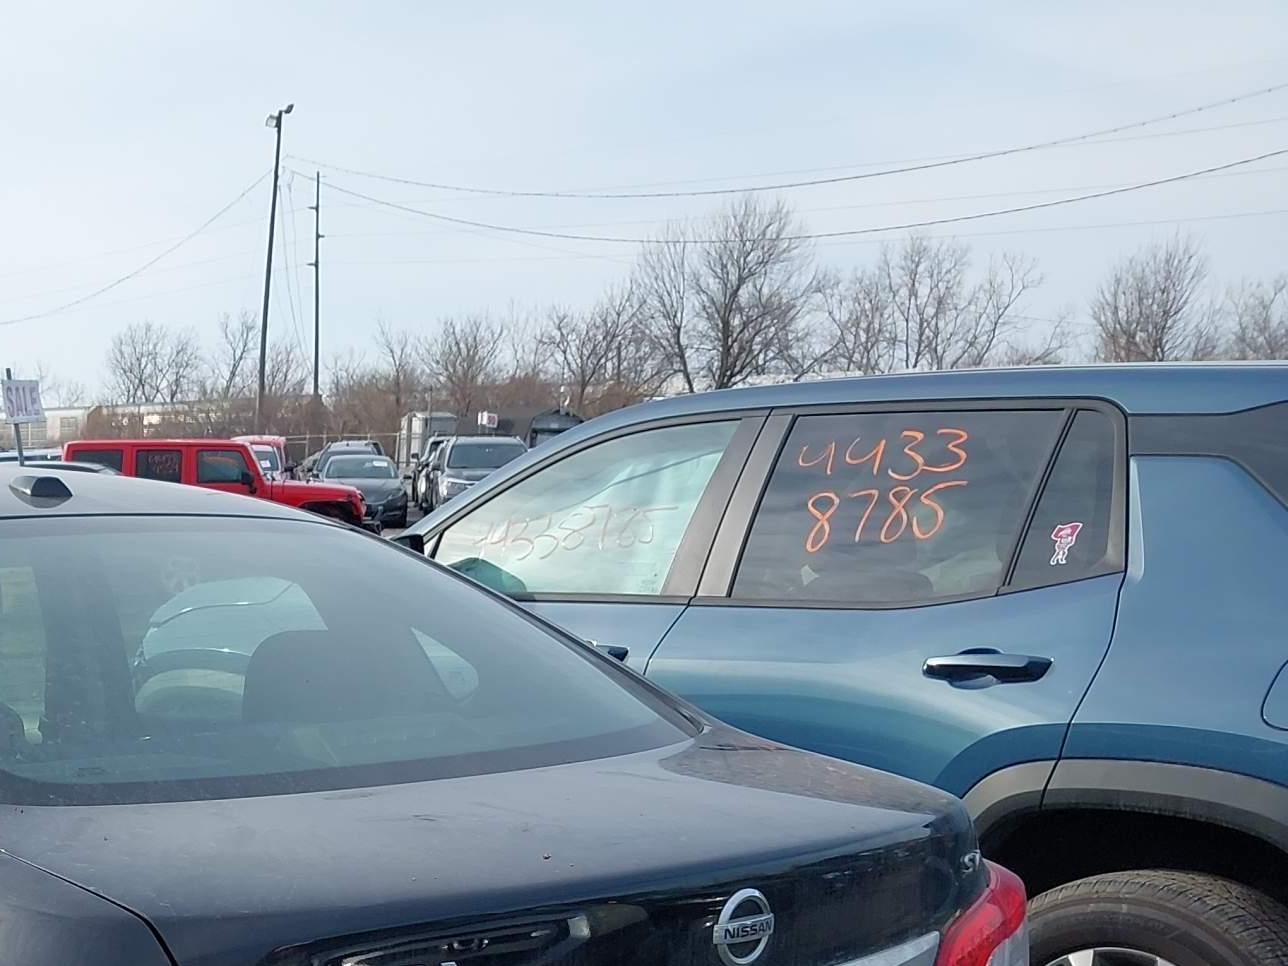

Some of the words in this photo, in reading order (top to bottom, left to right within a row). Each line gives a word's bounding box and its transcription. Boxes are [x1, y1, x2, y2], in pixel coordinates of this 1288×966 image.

[7, 386, 40, 417] SALE
[798, 428, 968, 480] 4433
[806, 480, 968, 552] 8785
[724, 919, 772, 940] NISSAN
